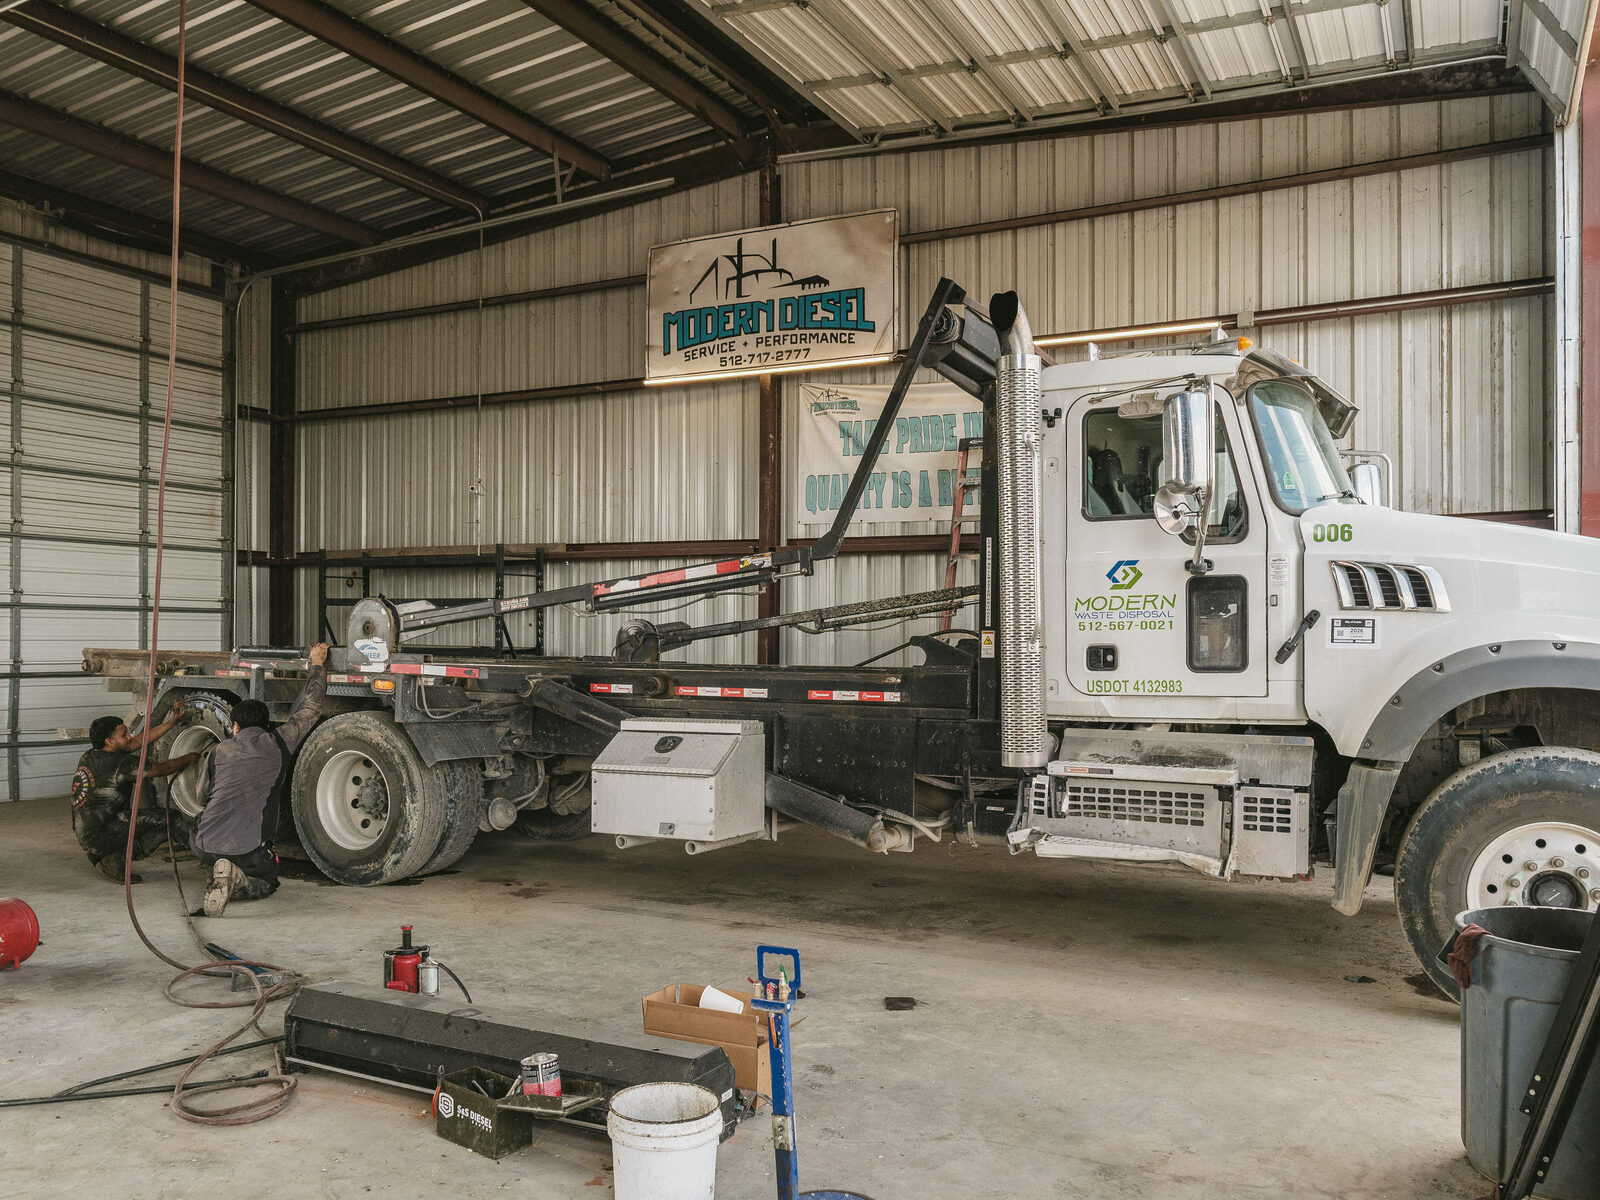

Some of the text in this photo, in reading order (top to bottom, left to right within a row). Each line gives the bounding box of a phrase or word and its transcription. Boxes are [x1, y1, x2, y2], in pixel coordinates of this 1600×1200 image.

[663, 287, 875, 356] MODERN DIESEL
[684, 340, 736, 362] SERVICE
[755, 332, 856, 348] PERFORMANCE
[896, 414, 957, 454] PRIDE
[892, 470, 912, 508] IS
[919, 470, 932, 507] A
[1313, 523, 1353, 542] 006
[1074, 594, 1176, 612] MODERN
[1074, 610, 1174, 619] WASTE DISPOSAL
[1078, 620, 1173, 631] 512-567-0021
[1086, 680, 1182, 693] USDOT 4132983
[470, 1110, 493, 1129] DIESEL
